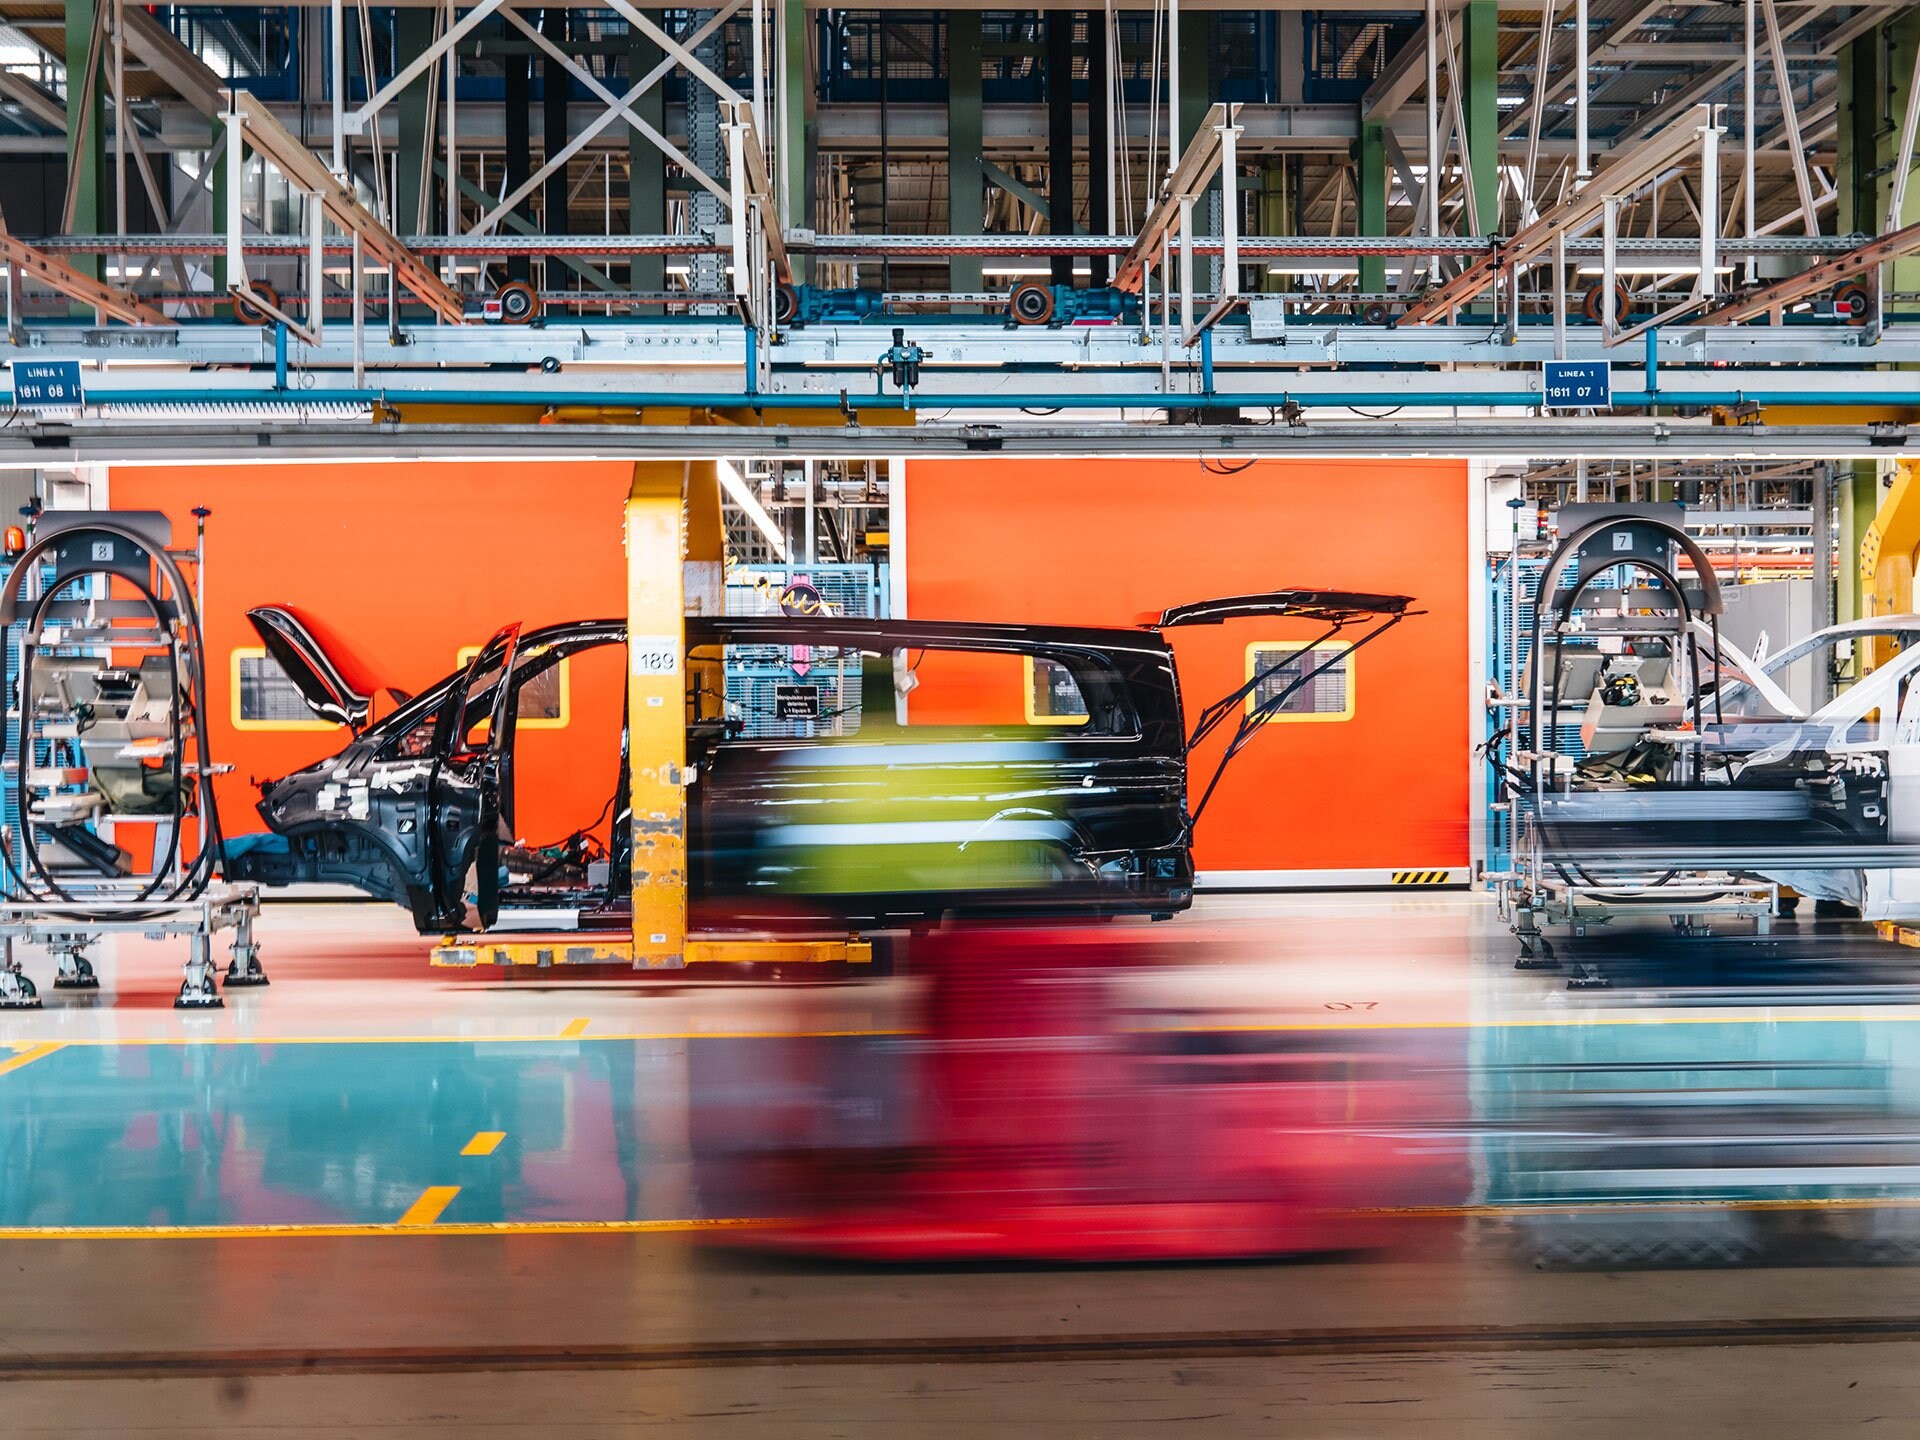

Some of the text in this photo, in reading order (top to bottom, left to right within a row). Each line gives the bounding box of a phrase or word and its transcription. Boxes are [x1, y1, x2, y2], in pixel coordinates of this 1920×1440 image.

[27, 367, 64, 377] LINEA 1
[48, 384, 63, 398] 08
[1549, 387, 1570, 397] 1611
[1577, 387, 1591, 397] 07
[1618, 535, 1627, 548] 7
[98, 545, 107, 559] 8
[641, 652, 674, 670] 189
[1324, 1002, 1378, 1010] 07
